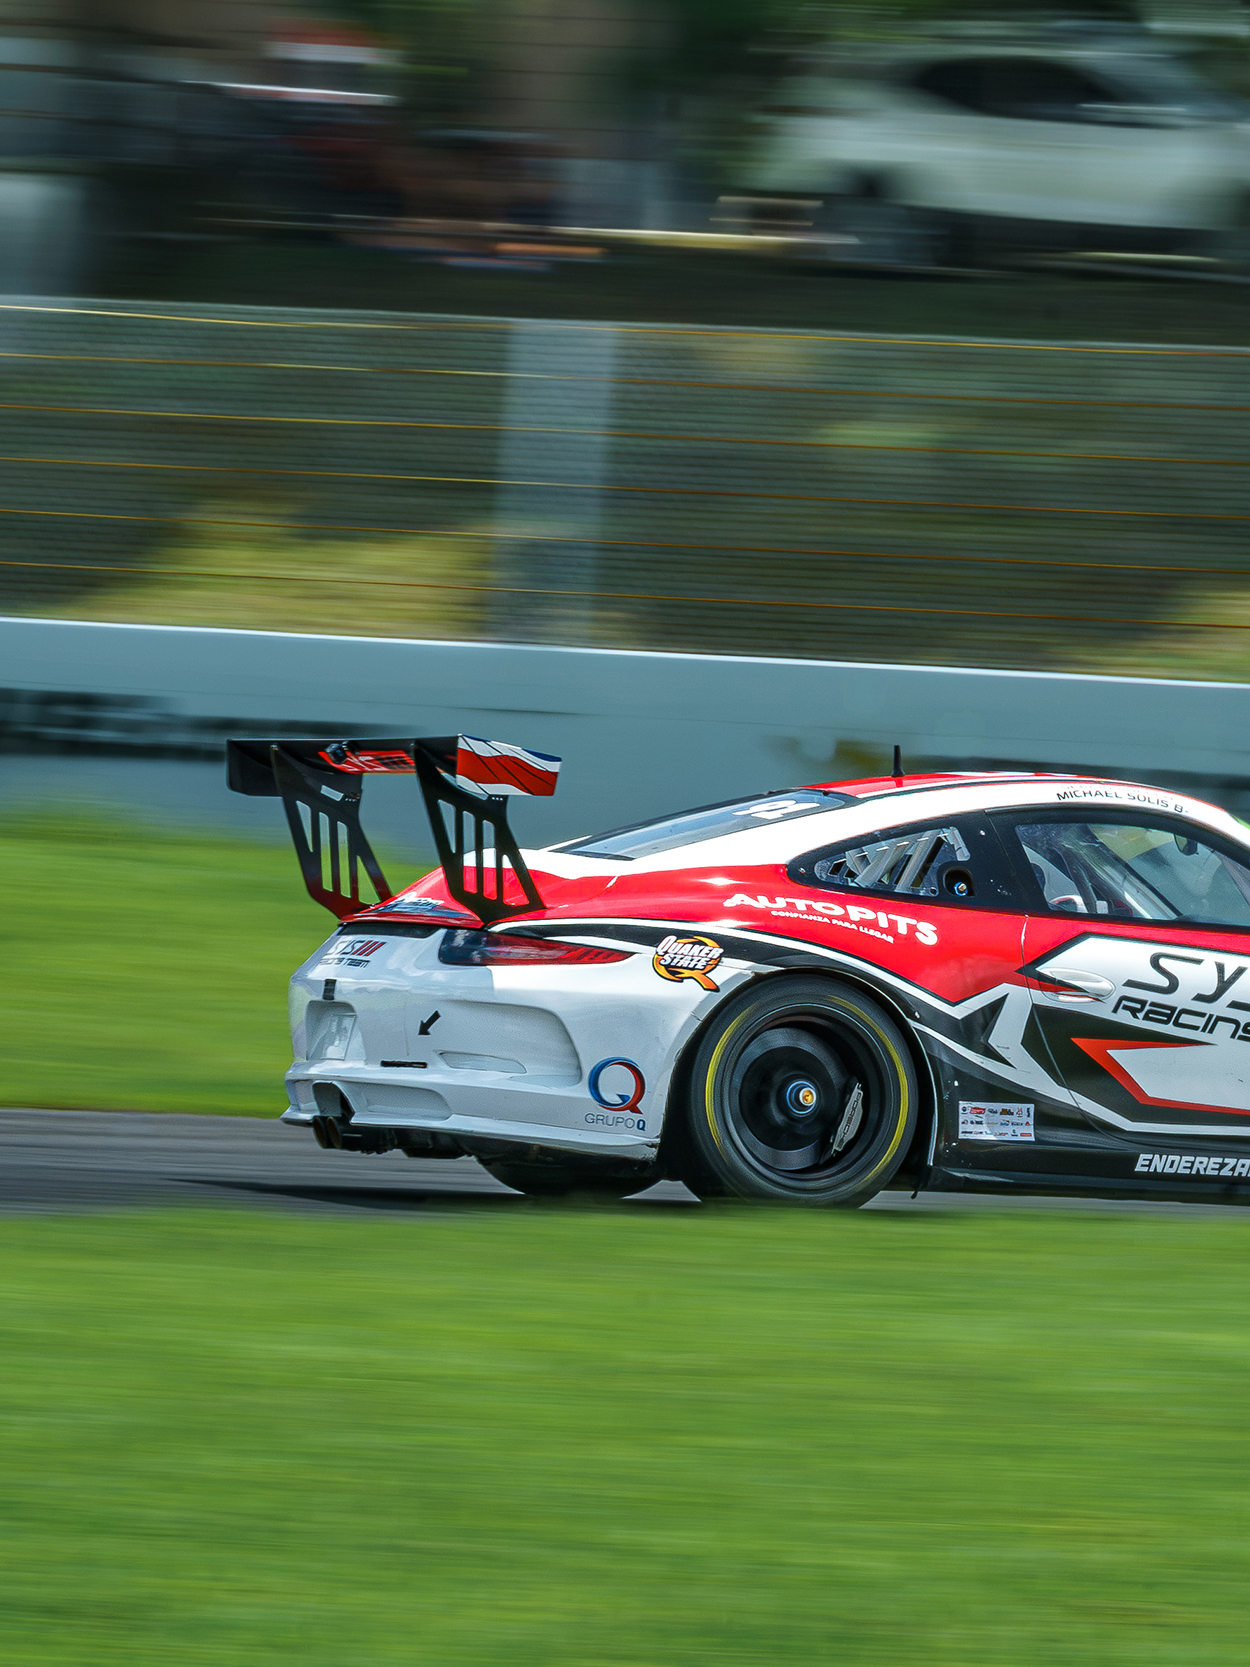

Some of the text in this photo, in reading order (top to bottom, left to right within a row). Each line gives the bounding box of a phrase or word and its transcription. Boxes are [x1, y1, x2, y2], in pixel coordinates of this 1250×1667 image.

[1056, 789, 1123, 801] MICHAEL
[1127, 793, 1169, 808] SOLIS
[771, 910, 894, 944] CONFIANZA PARA LLEGAR
[656, 935, 724, 959] QUAKER
[660, 953, 710, 970] STATE
[584, 1112, 647, 1132] GRUPO Q
